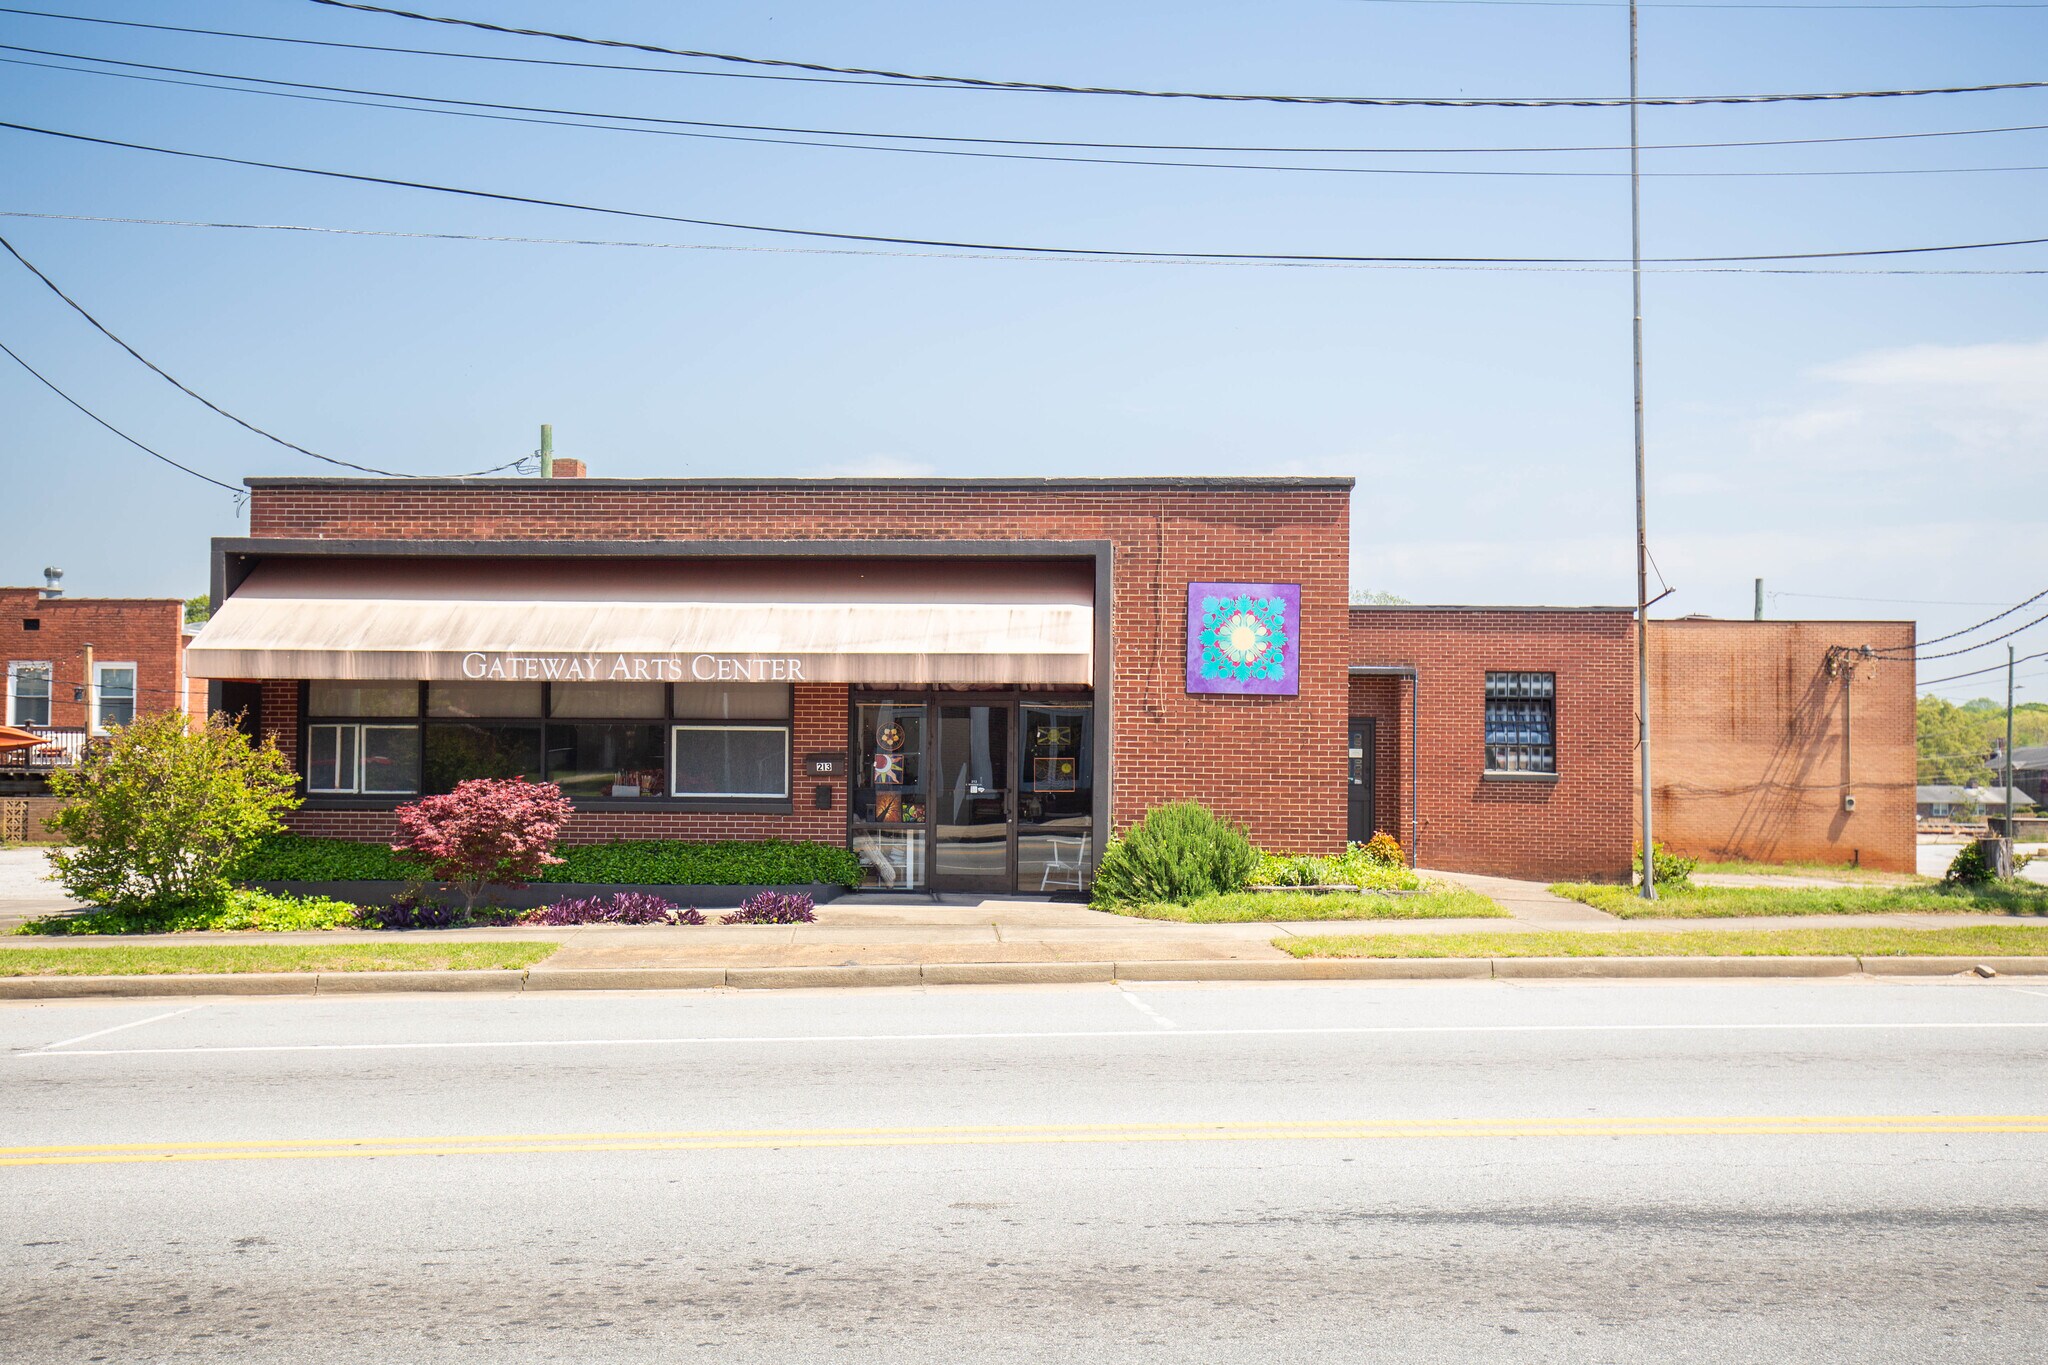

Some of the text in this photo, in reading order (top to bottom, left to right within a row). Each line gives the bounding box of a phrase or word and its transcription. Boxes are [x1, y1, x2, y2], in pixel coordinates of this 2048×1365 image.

[462, 652, 806, 681] GATEWAY ARTS CENTER
[817, 763, 832, 771] 213
